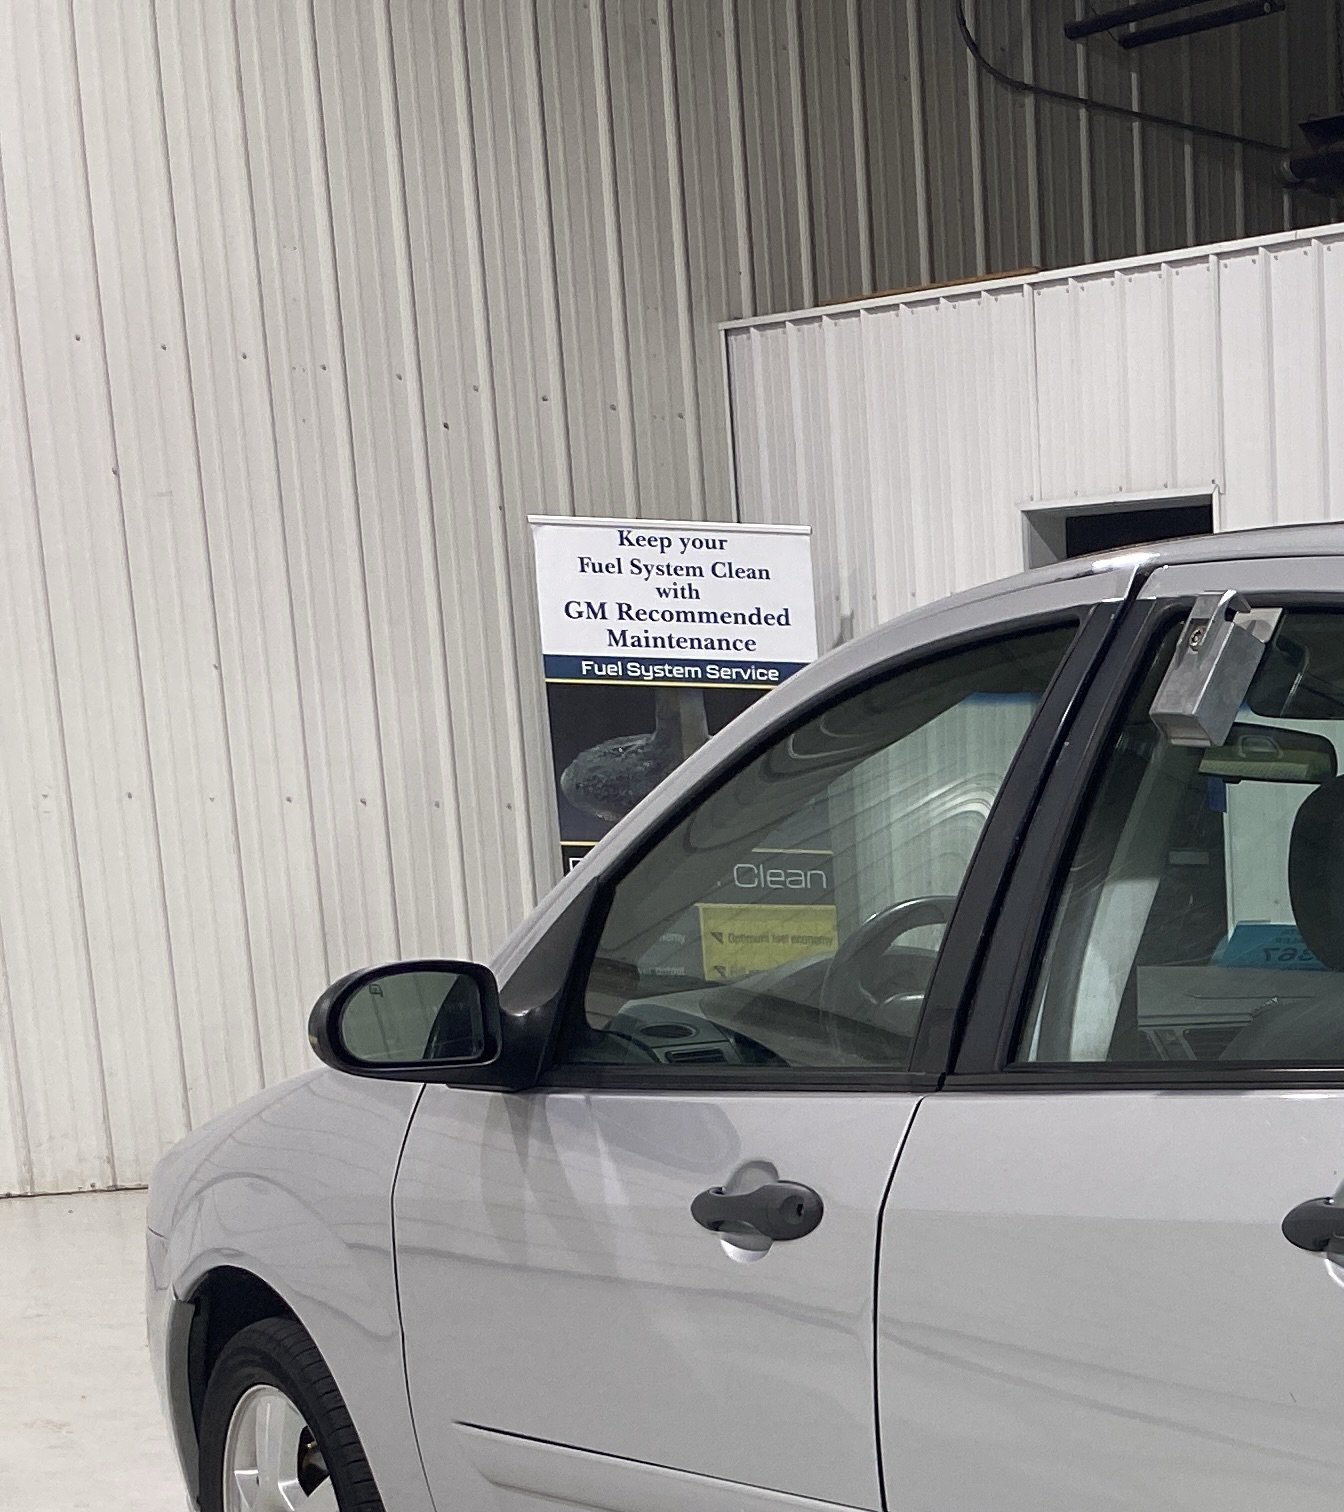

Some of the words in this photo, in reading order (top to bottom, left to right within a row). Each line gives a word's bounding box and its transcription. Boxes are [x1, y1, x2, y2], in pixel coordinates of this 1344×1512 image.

[617, 530, 672, 554] Keep
[679, 537, 728, 554] your
[578, 556, 623, 575] Fuel
[630, 558, 705, 581] System
[711, 561, 771, 580] Clean
[656, 582, 700, 600] with
[564, 601, 607, 620] GM
[616, 602, 791, 626] Recommended
[606, 629, 757, 651] Maintenance
[581, 661, 622, 676] Fuel
[627, 662, 701, 680] System
[706, 664, 779, 681] Service
[733, 863, 827, 889] Clean
